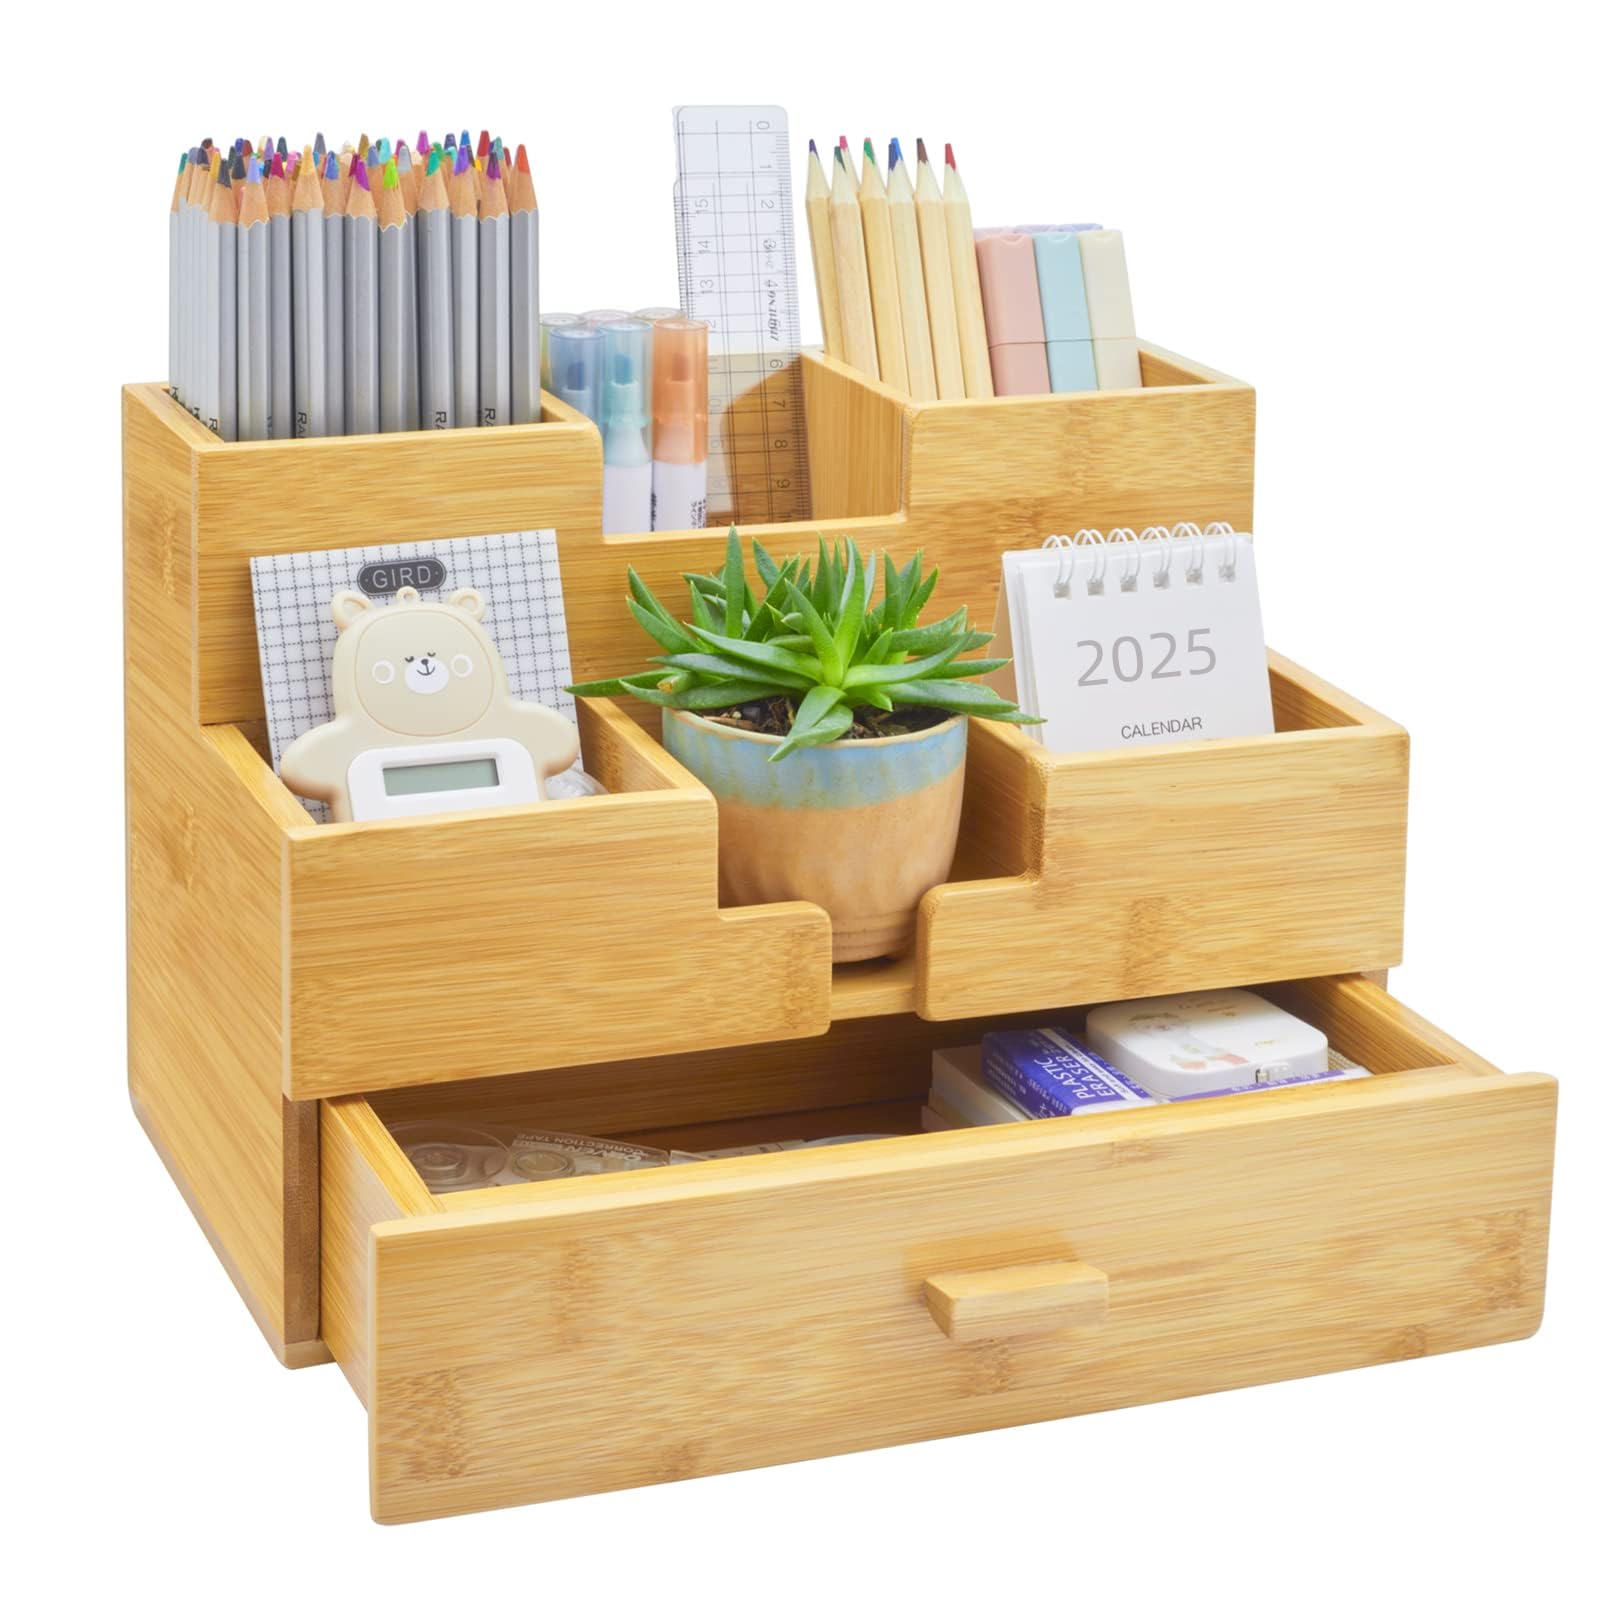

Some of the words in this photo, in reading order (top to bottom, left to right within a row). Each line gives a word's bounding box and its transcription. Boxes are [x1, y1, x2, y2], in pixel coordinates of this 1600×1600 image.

[761, 199, 775, 209] 2
[769, 359, 783, 369] 6
[773, 399, 786, 409] 7
[774, 439, 788, 449] 8
[776, 479, 791, 489] 9
[372, 565, 432, 589] GIRD
[1076, 627, 1217, 687] 2025
[1120, 716, 1203, 740] CALENDAR
[1033, 1056, 1096, 1100] PLASTIC
[1056, 1054, 1117, 1097] ERASER
